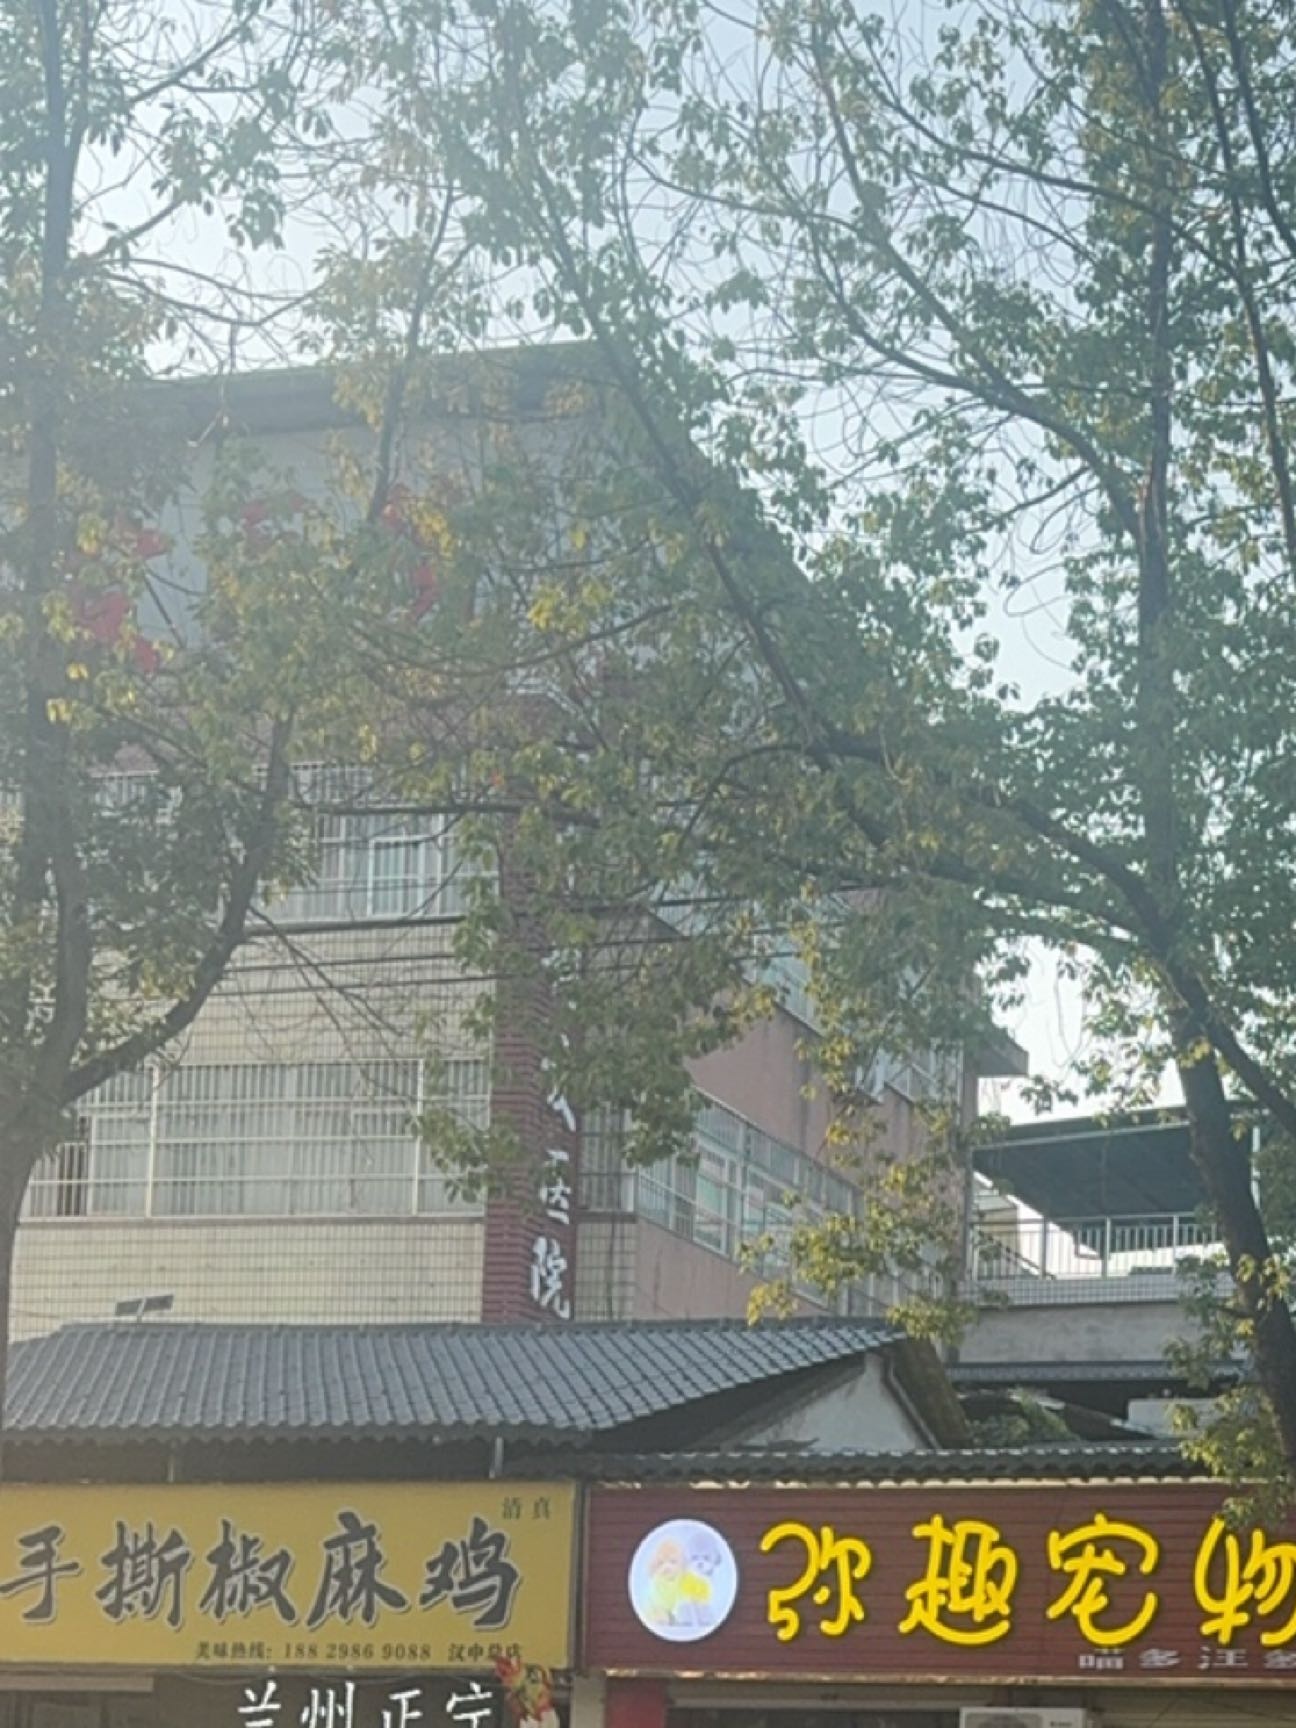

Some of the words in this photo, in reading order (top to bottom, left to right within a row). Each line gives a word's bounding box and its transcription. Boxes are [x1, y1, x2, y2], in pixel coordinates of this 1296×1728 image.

[0, 1512, 522, 1628] 手撕椒麻鸡
